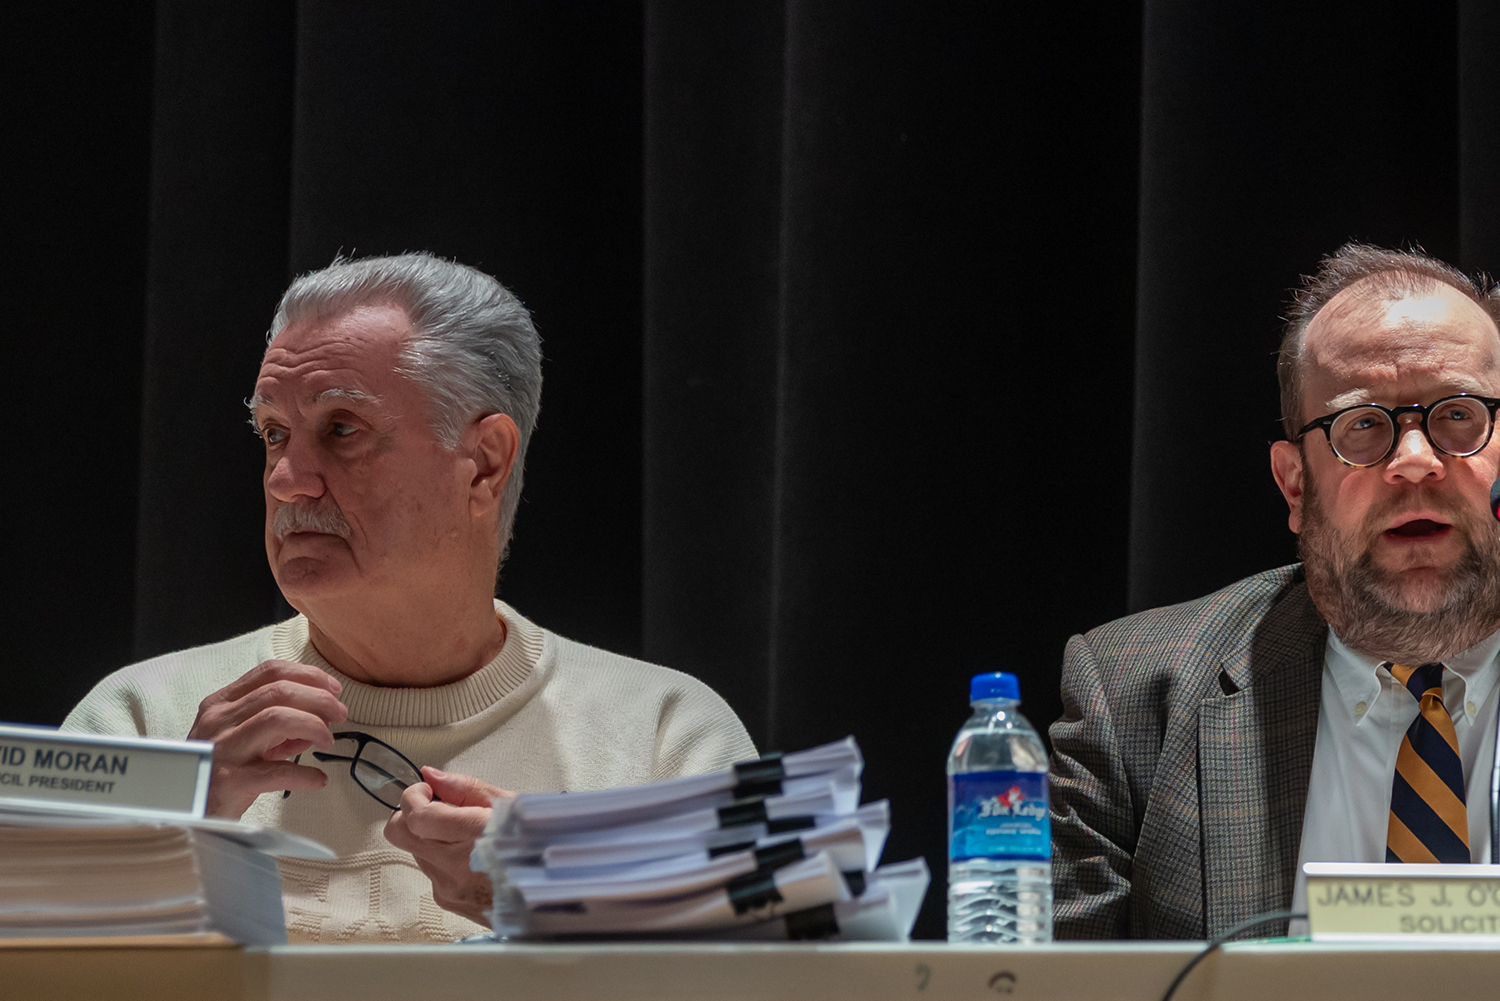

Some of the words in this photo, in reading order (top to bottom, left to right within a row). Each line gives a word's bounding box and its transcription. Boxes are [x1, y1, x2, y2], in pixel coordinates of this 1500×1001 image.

[33, 749, 128, 775] MORAN
[0, 772, 24, 786] CIL
[28, 775, 115, 794] PRESIDENT
[1316, 883, 1416, 907] JAMES
[1430, 884, 1453, 907] J.
